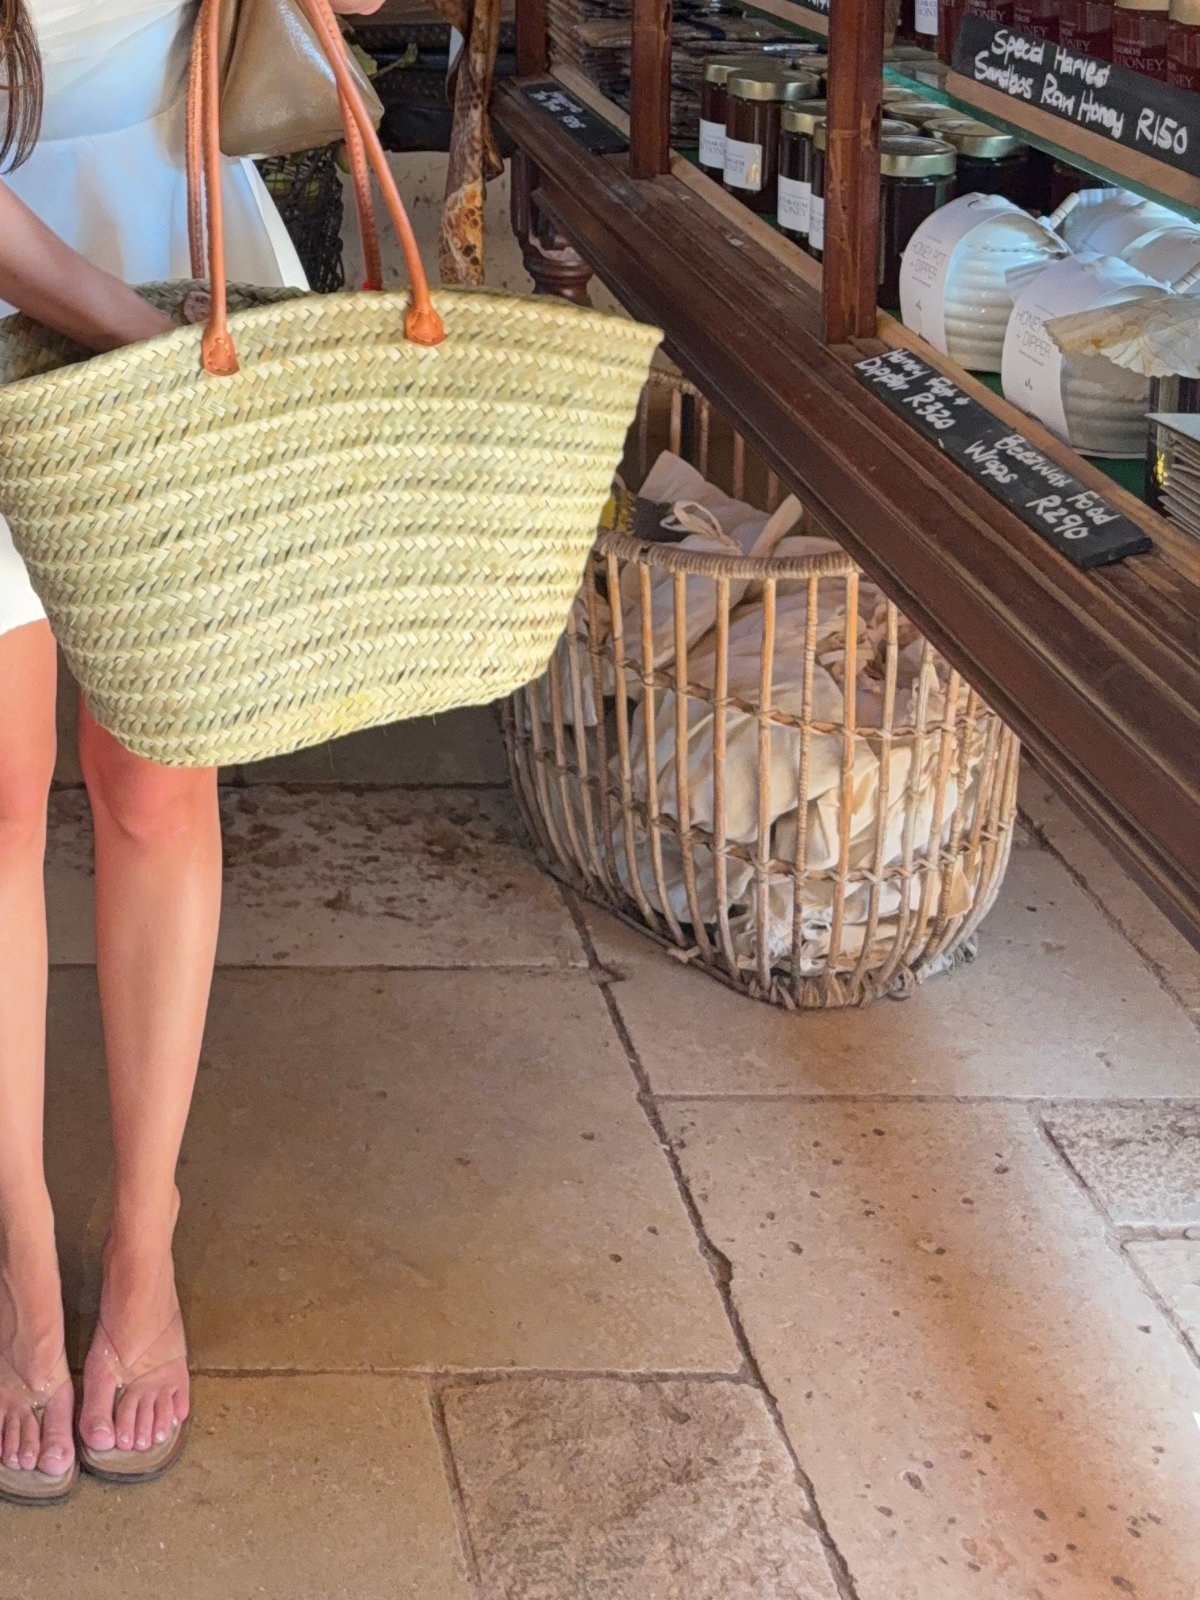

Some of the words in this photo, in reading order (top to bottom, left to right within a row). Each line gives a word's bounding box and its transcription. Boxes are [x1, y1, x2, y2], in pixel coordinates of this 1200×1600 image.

[991, 28, 1046, 67] Special
[1077, 88, 1125, 139] Honey
[1135, 106, 1188, 155] R150
[902, 391, 958, 431] R320
[963, 439, 1020, 484] Wraps
[1024, 494, 1090, 540] R290
[1065, 490, 1122, 526] Food
